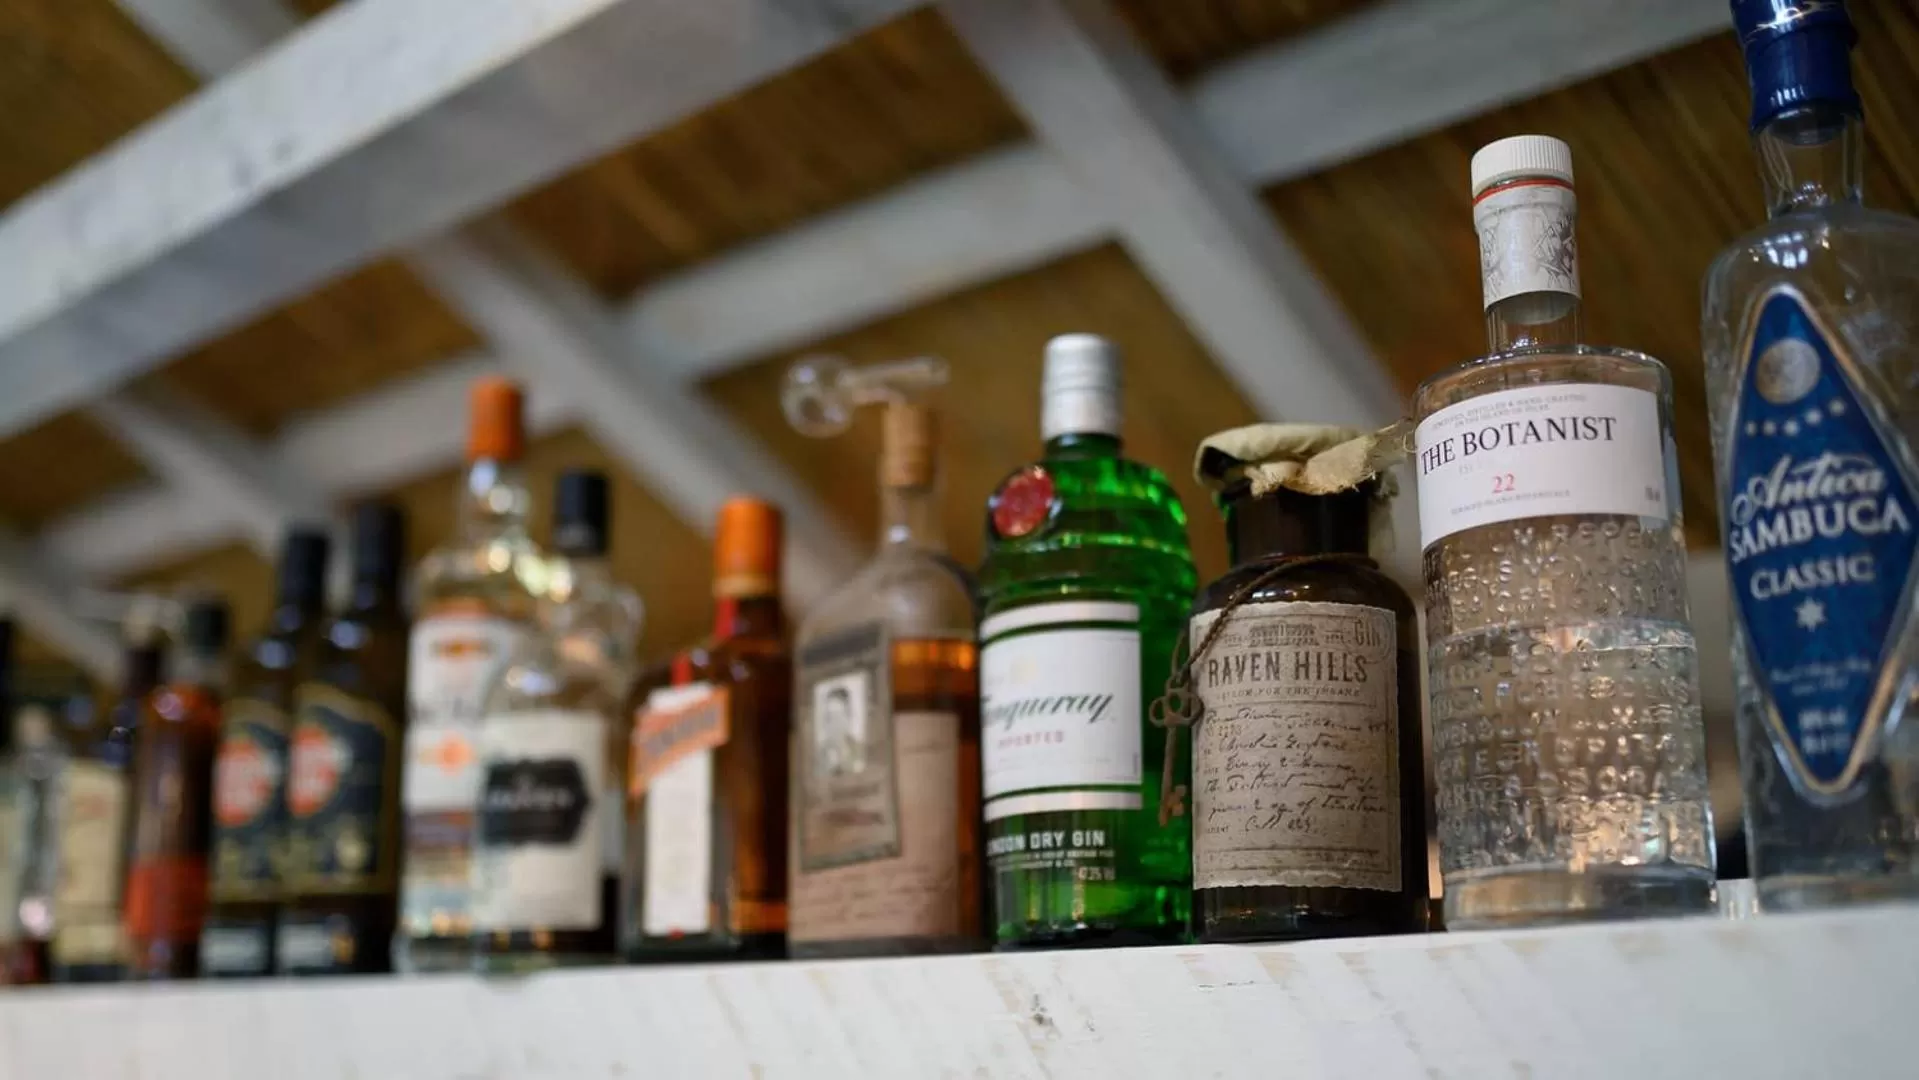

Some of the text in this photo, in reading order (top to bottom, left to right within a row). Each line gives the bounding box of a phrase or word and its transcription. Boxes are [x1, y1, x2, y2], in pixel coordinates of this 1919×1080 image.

[1421, 438, 1456, 475] THE
[1461, 416, 1617, 456] BOTANIST
[1492, 473, 1516, 494] 22
[1731, 452, 1886, 525] Antica
[1730, 494, 1911, 565] SAMBUCA
[1750, 553, 1876, 600] CLASSIC
[1208, 651, 1369, 689] RAVEN HILLS
[1030, 831, 1065, 850] DRY
[1072, 829, 1105, 848] GIN
